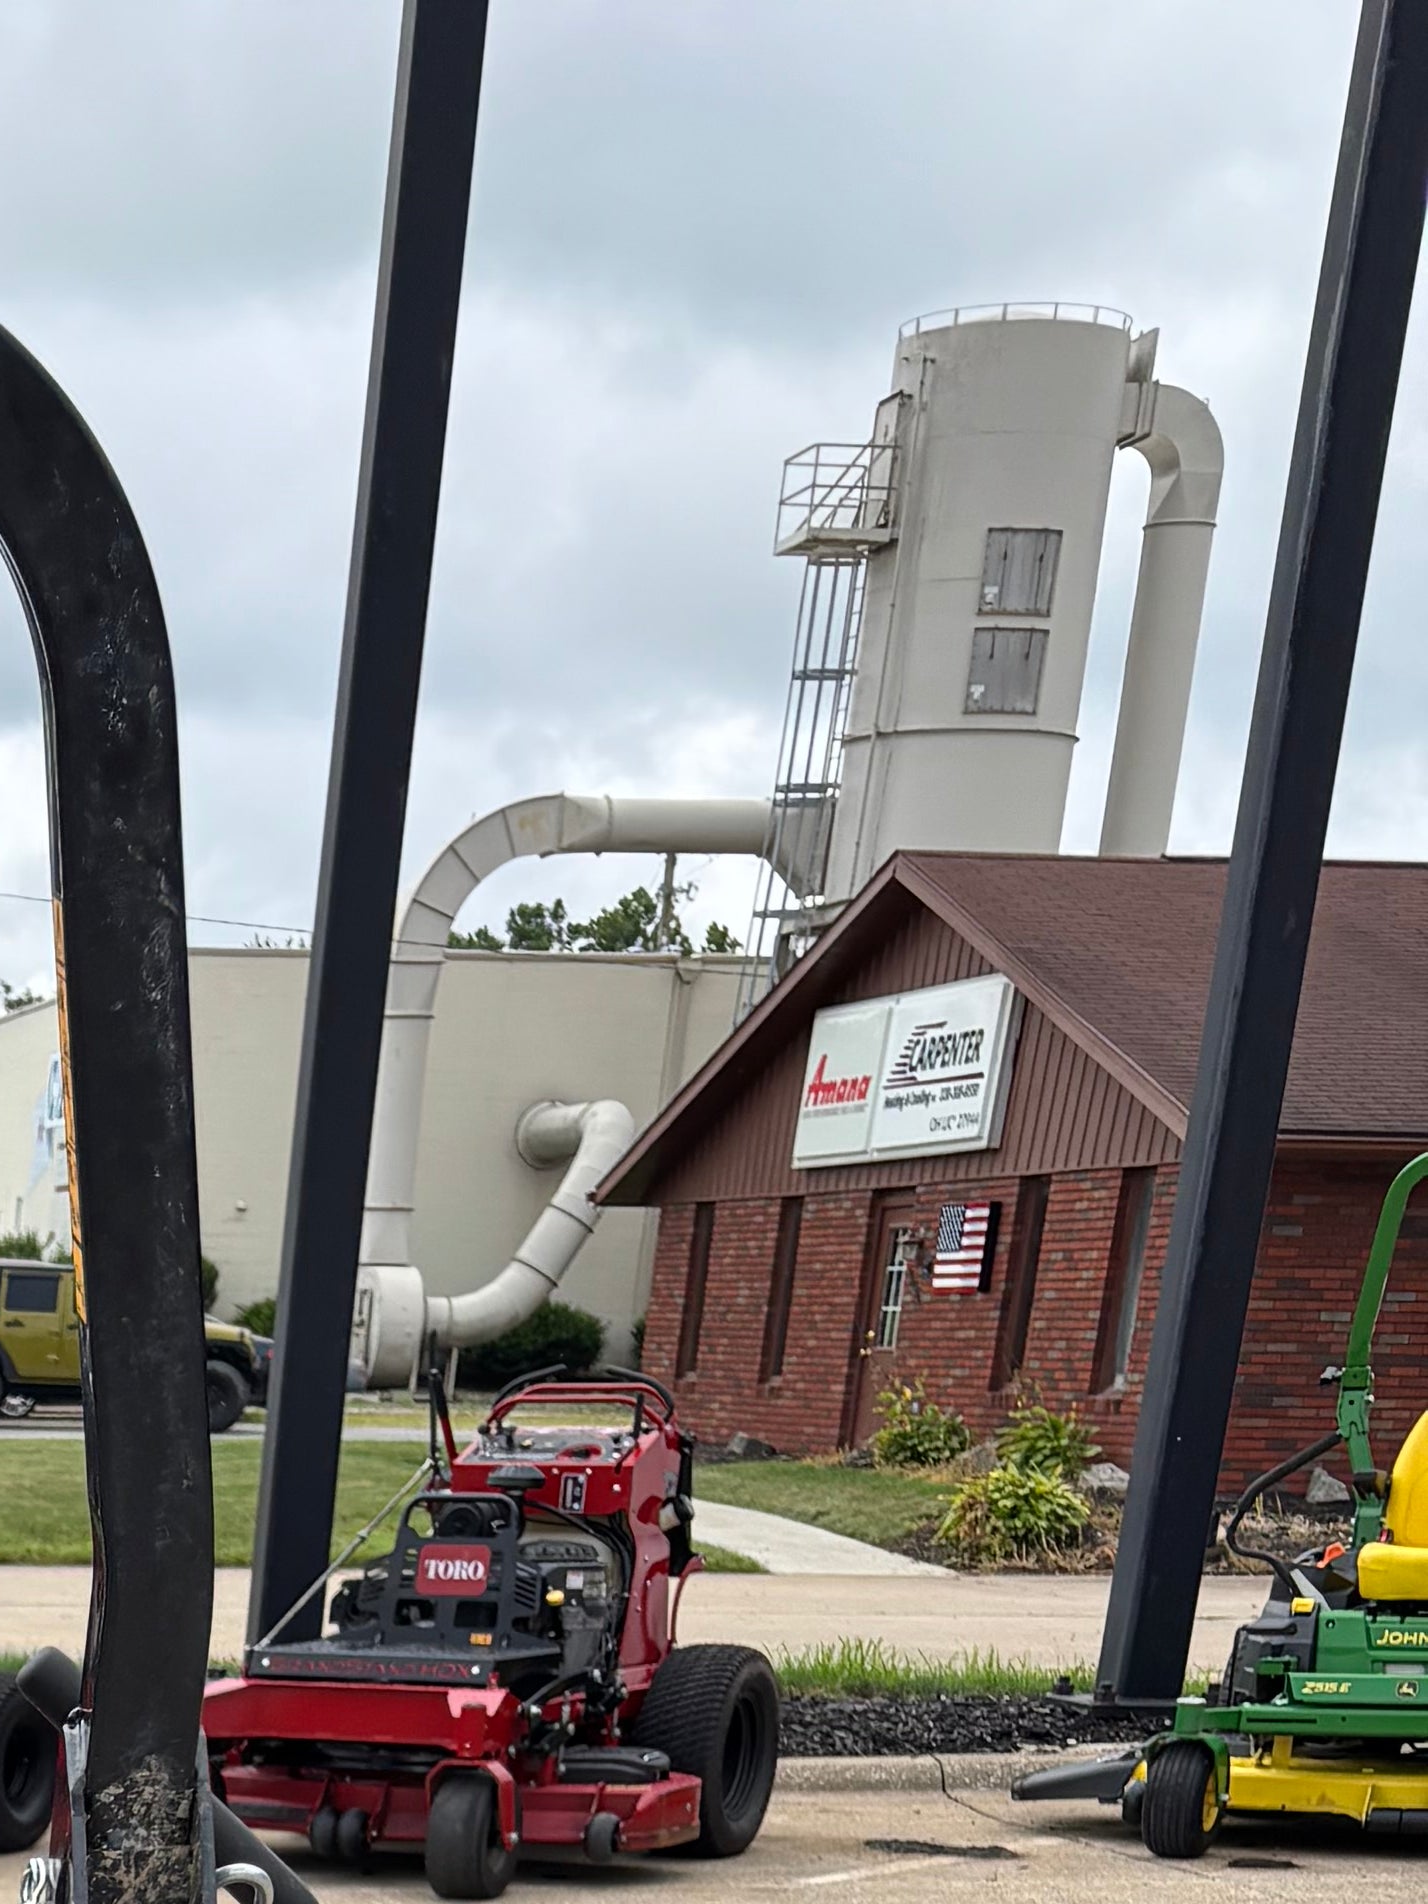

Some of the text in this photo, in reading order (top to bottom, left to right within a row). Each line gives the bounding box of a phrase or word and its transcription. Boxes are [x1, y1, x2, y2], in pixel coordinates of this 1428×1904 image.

[908, 1028, 985, 1073] CARPENTER
[803, 1053, 872, 1108] Amana
[424, 1559, 487, 1581] TORO
